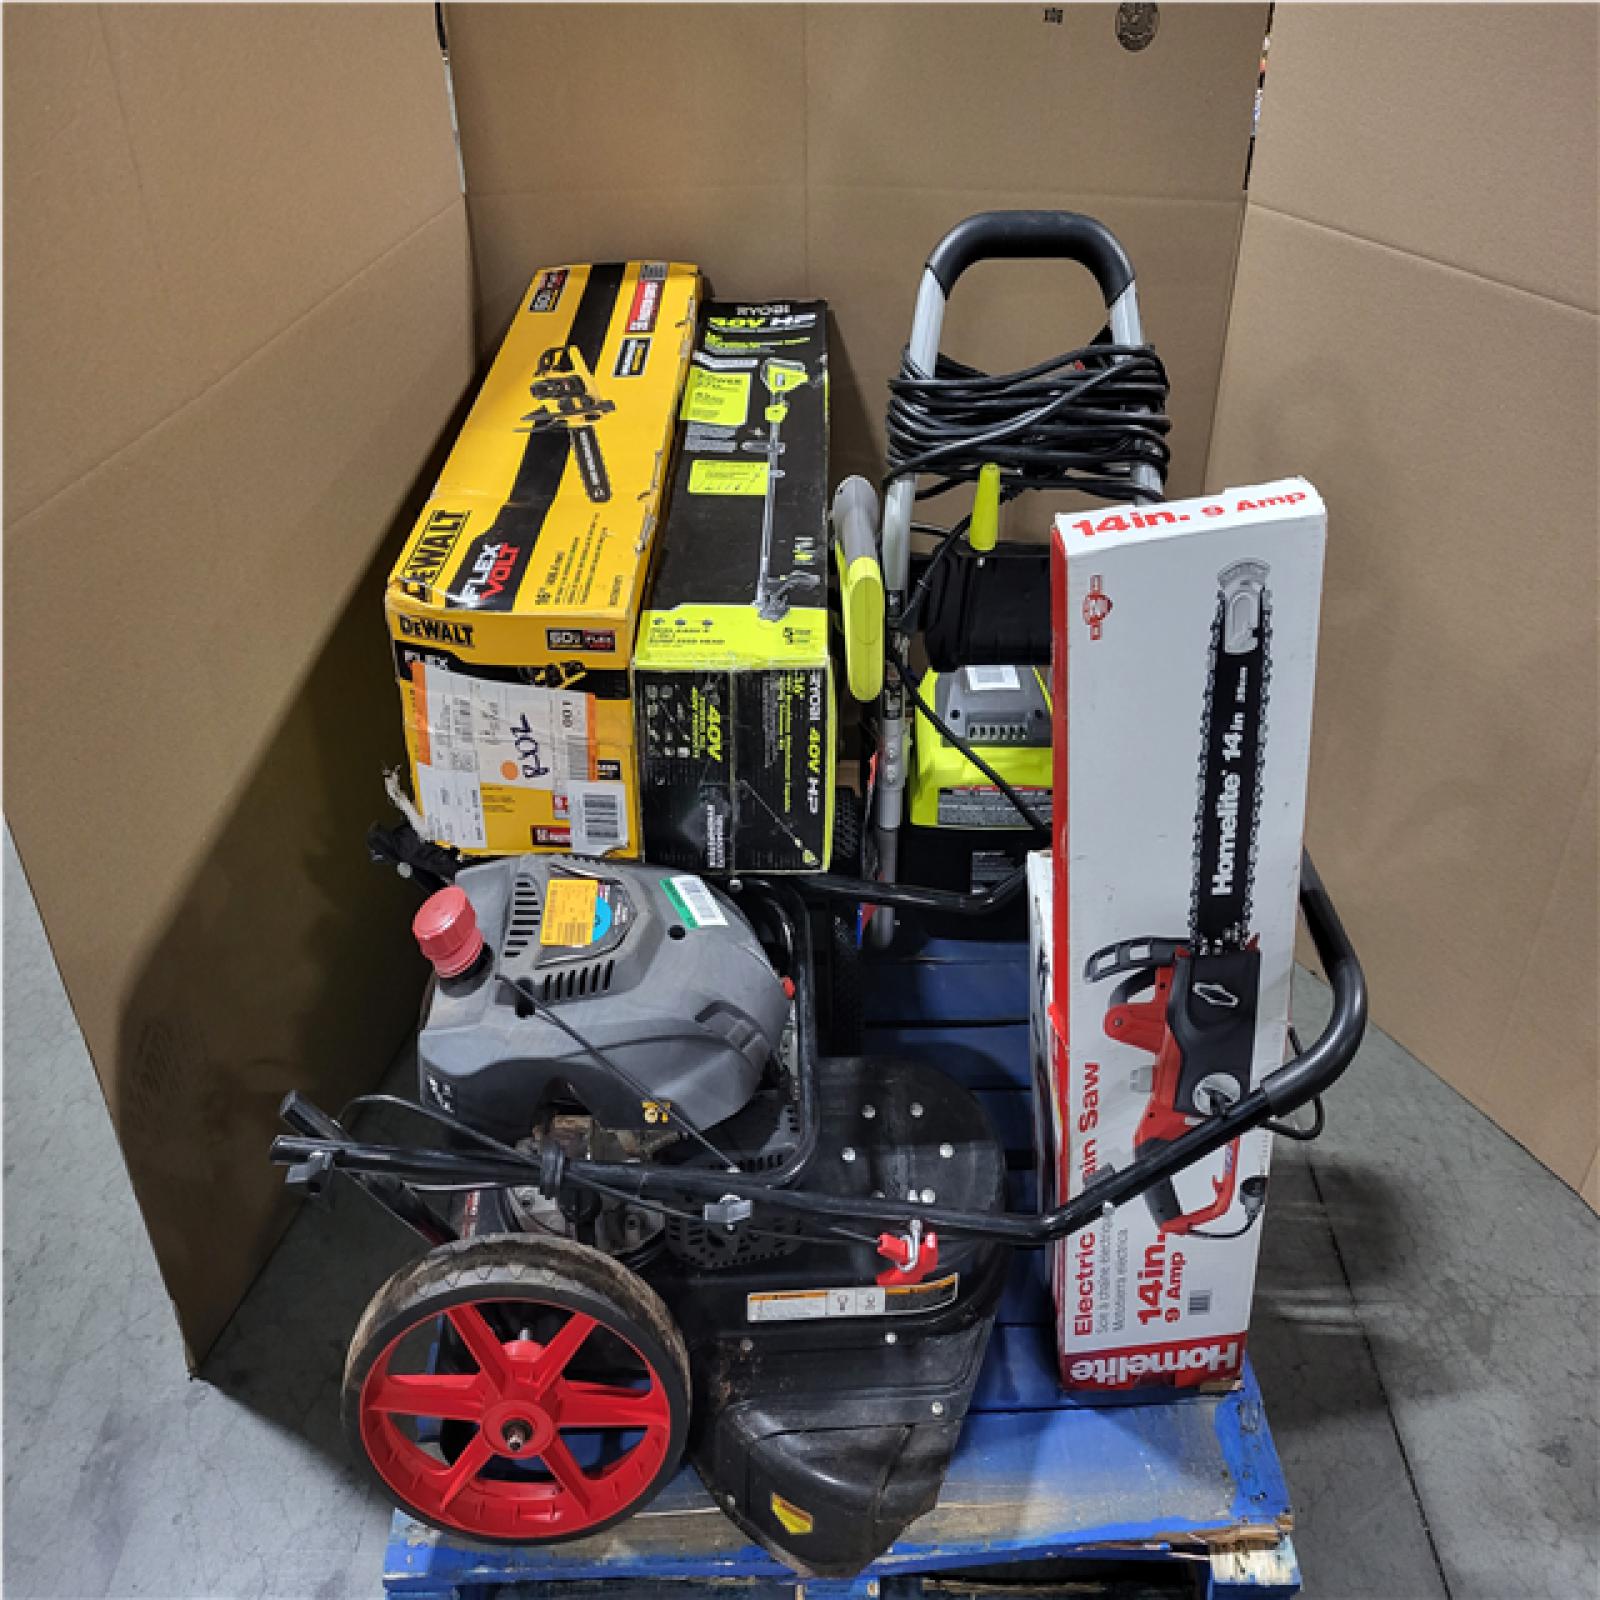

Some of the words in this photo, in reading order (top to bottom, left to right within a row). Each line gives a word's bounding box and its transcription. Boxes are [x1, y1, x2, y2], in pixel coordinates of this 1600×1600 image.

[1071, 510, 1190, 536] 14in.
[1236, 491, 1306, 513] Amp
[459, 543, 502, 608] FLEX
[479, 542, 519, 599] VOLT
[1211, 773, 1241, 896] Homelite
[1077, 1061, 1100, 1134] Saw
[1074, 1232, 1095, 1335] Electric
[1137, 1234, 1166, 1326] 14in.
[1165, 1251, 1186, 1300] Amp
[1164, 1307, 1181, 1323] 9
[1071, 1342, 1239, 1386] Homelite
